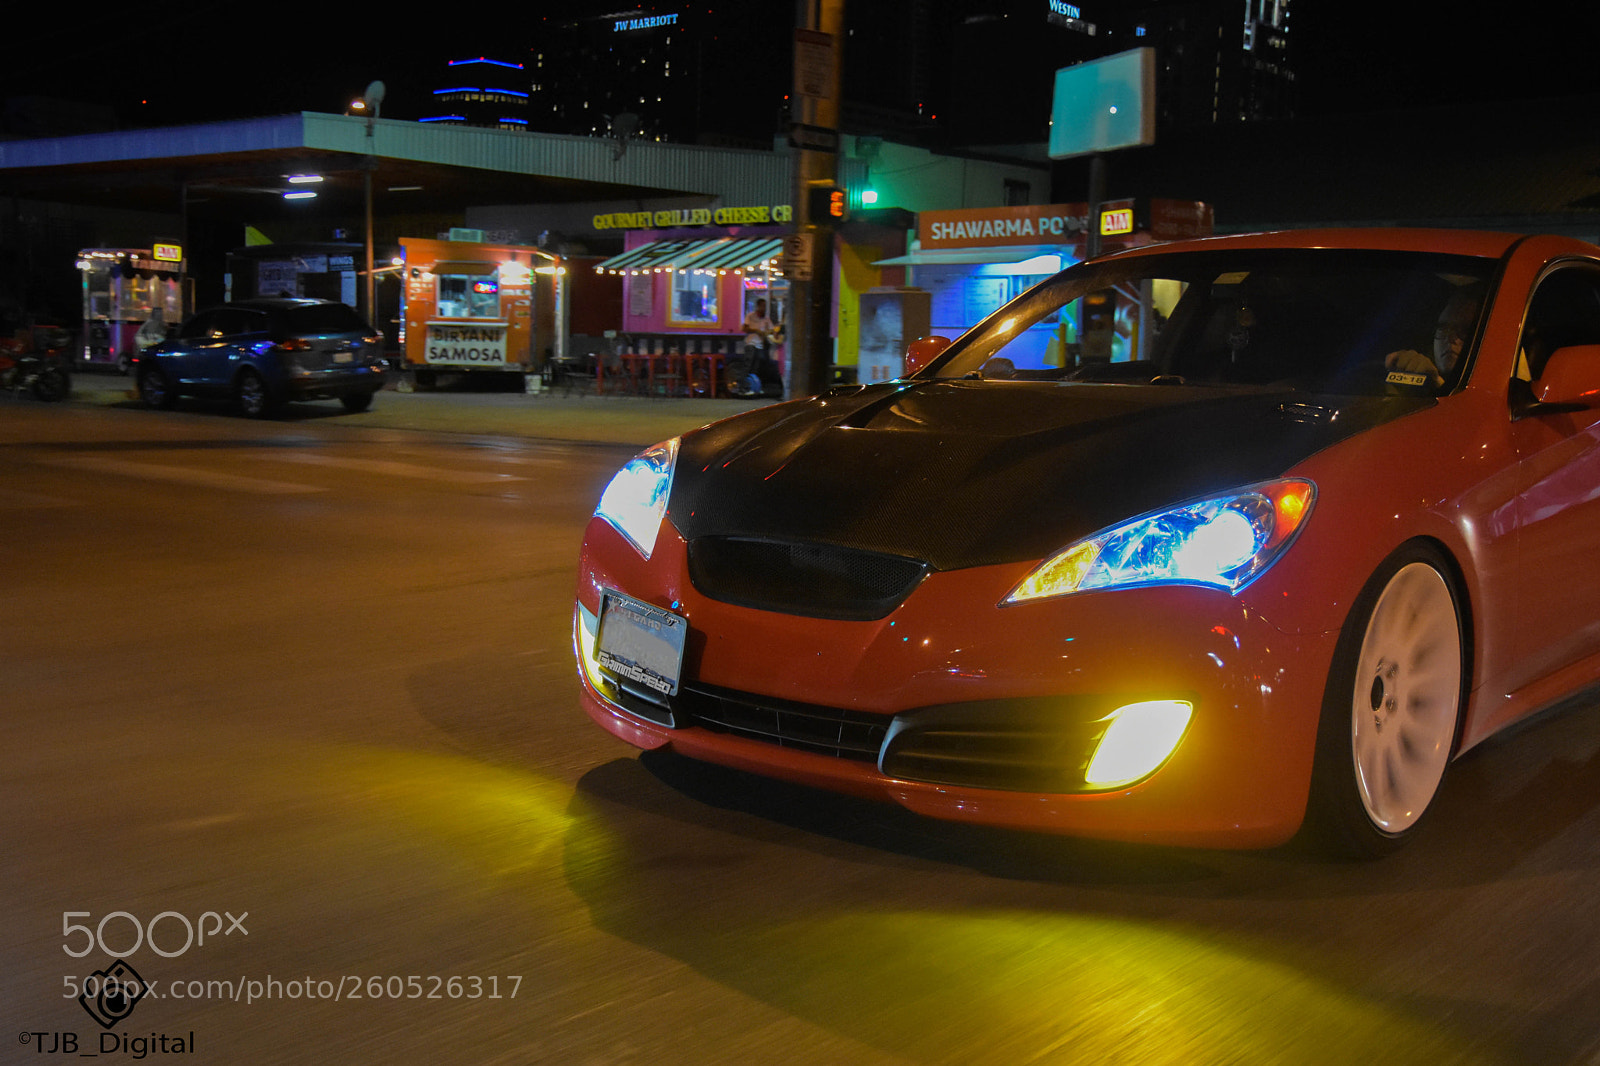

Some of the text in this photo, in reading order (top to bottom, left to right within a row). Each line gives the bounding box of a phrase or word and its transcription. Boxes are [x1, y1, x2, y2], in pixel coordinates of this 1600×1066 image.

[613, 13, 679, 33] JW MARRIOTT
[593, 211, 653, 230] GOURMET
[654, 208, 712, 226] GRILLED
[714, 206, 770, 225] CHEESE
[930, 217, 1035, 240] SHAWARMA
[433, 328, 501, 343] BIRYANI
[429, 347, 503, 362] SAMOSA
